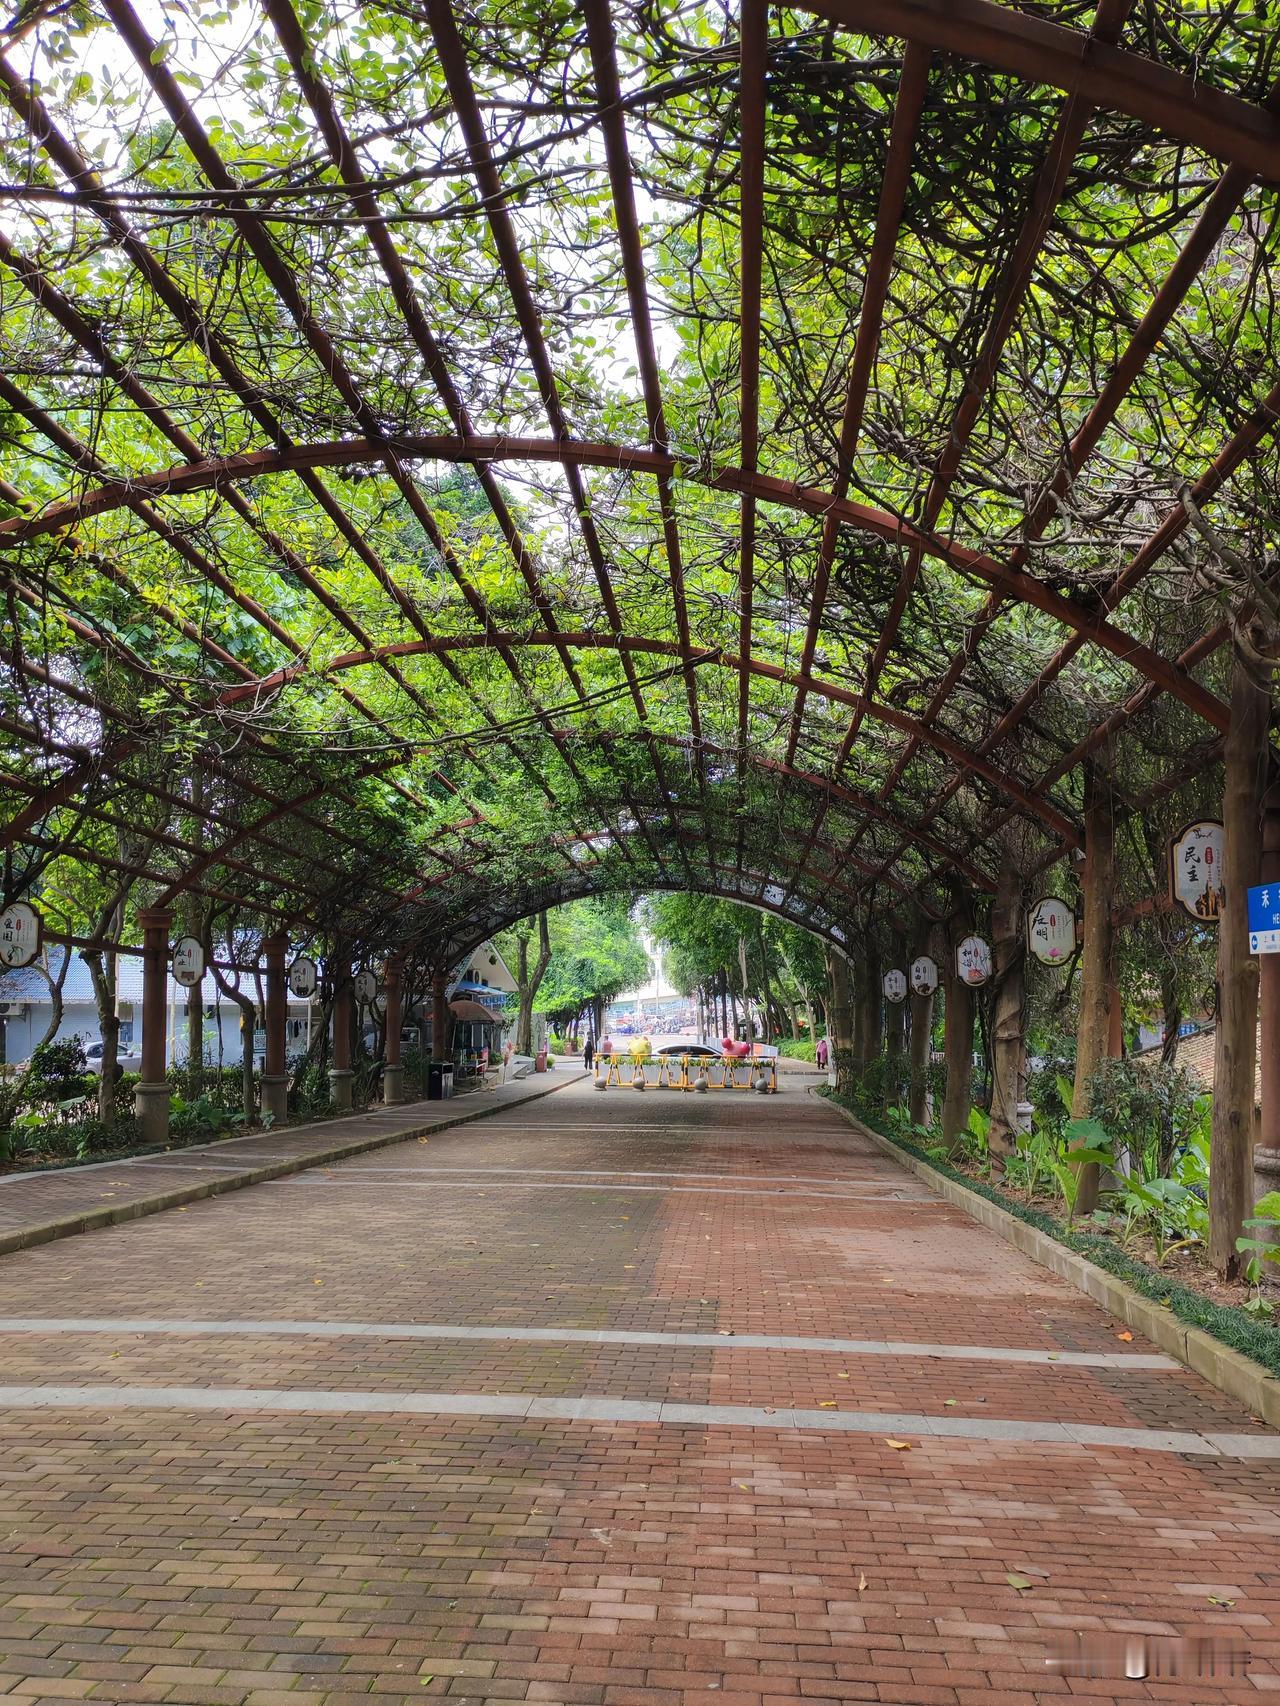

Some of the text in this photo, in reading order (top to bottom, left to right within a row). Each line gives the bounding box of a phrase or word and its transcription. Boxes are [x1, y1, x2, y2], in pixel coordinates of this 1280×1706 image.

[1184, 846, 1201, 882] 民主
[3, 918, 14, 942] 爱国
[1034, 913, 1049, 941] 文明
[176, 949, 188, 966] 敬业
[915, 966, 922, 980] 自由
